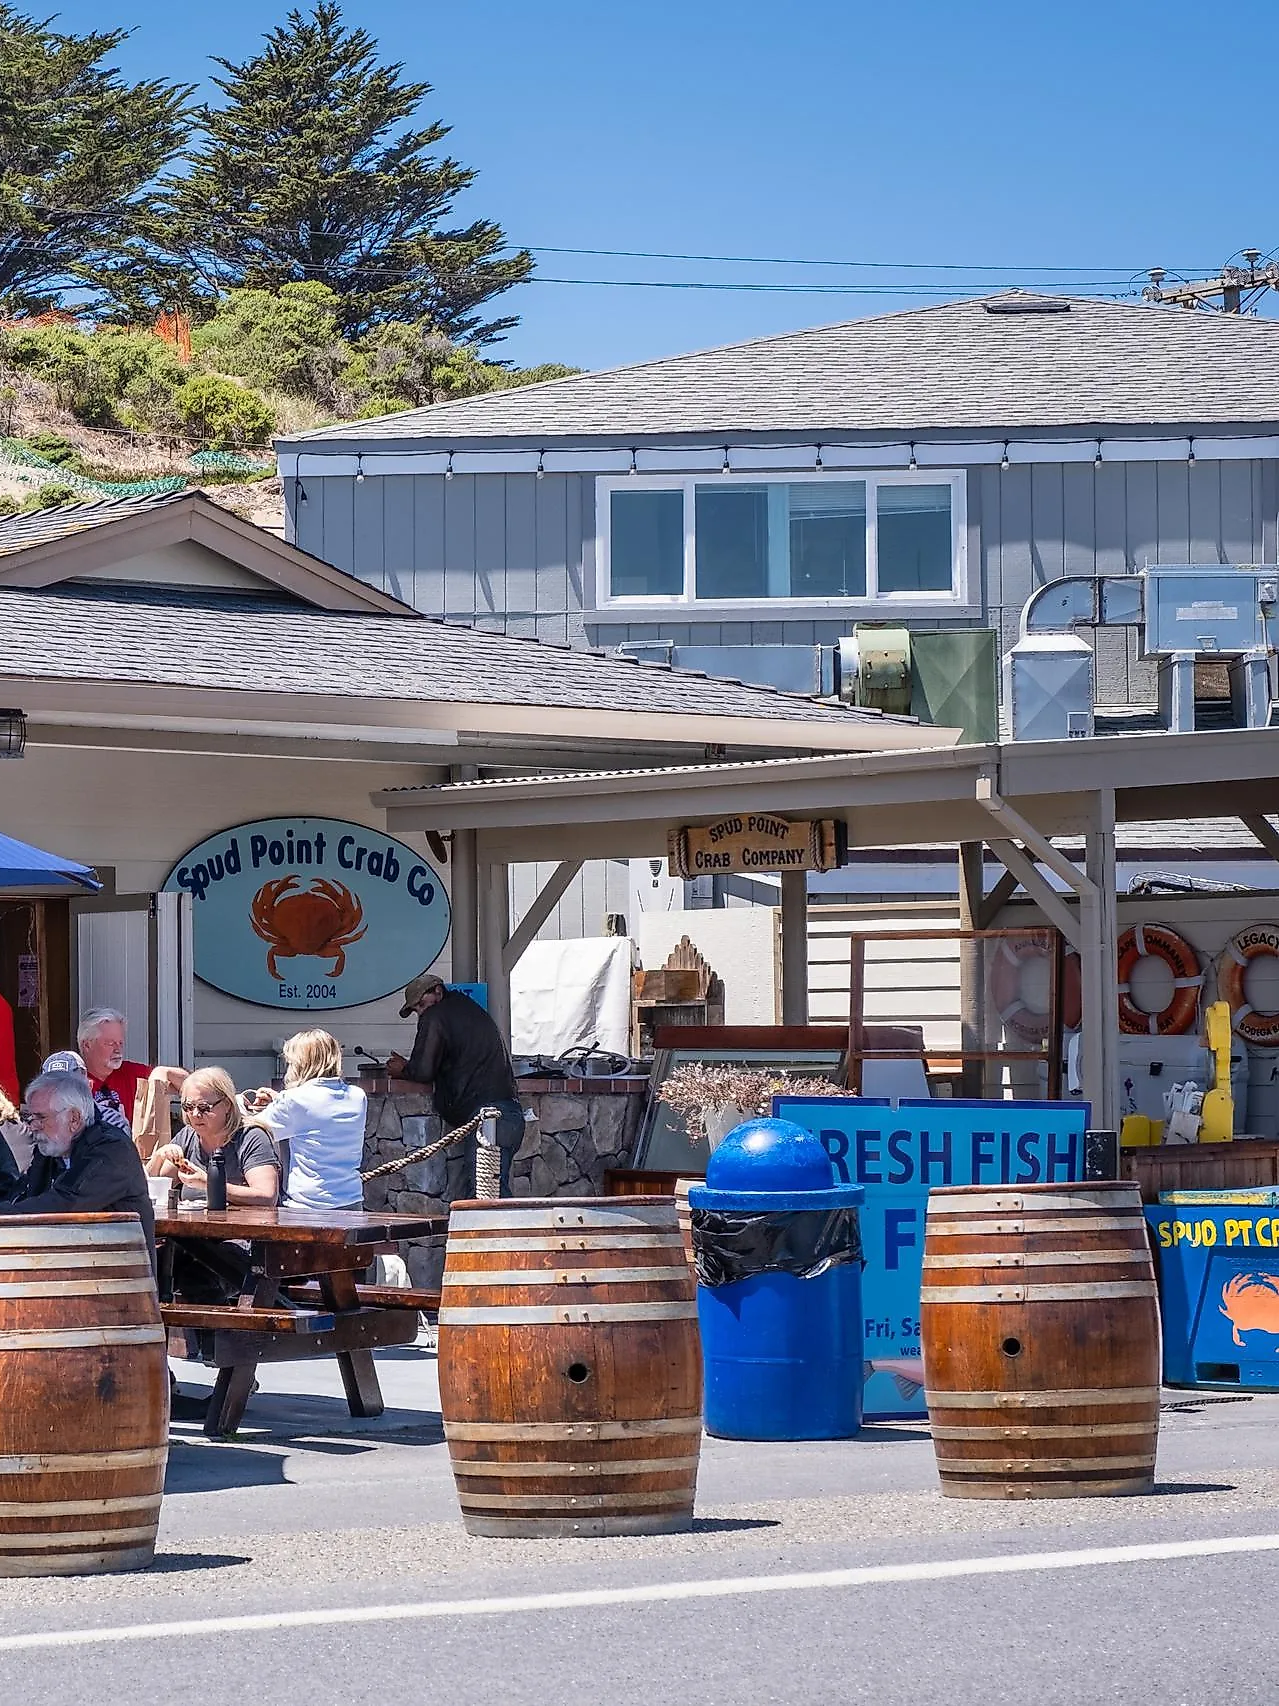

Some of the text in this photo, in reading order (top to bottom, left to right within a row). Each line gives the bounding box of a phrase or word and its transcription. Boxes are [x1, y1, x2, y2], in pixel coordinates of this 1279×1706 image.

[710, 816, 790, 843] SPUD POINT
[176, 829, 435, 906] Spud Point Crab Co
[695, 847, 805, 869] CRAB COMPANY
[279, 984, 337, 999] Est. 2004
[1240, 1022, 1272, 1037] BODEGA
[808, 1129, 1078, 1185] RESH FISH
[1158, 1219, 1217, 1248] SPUD
[1224, 1219, 1253, 1247] PT
[864, 1318, 896, 1340] Fri,
